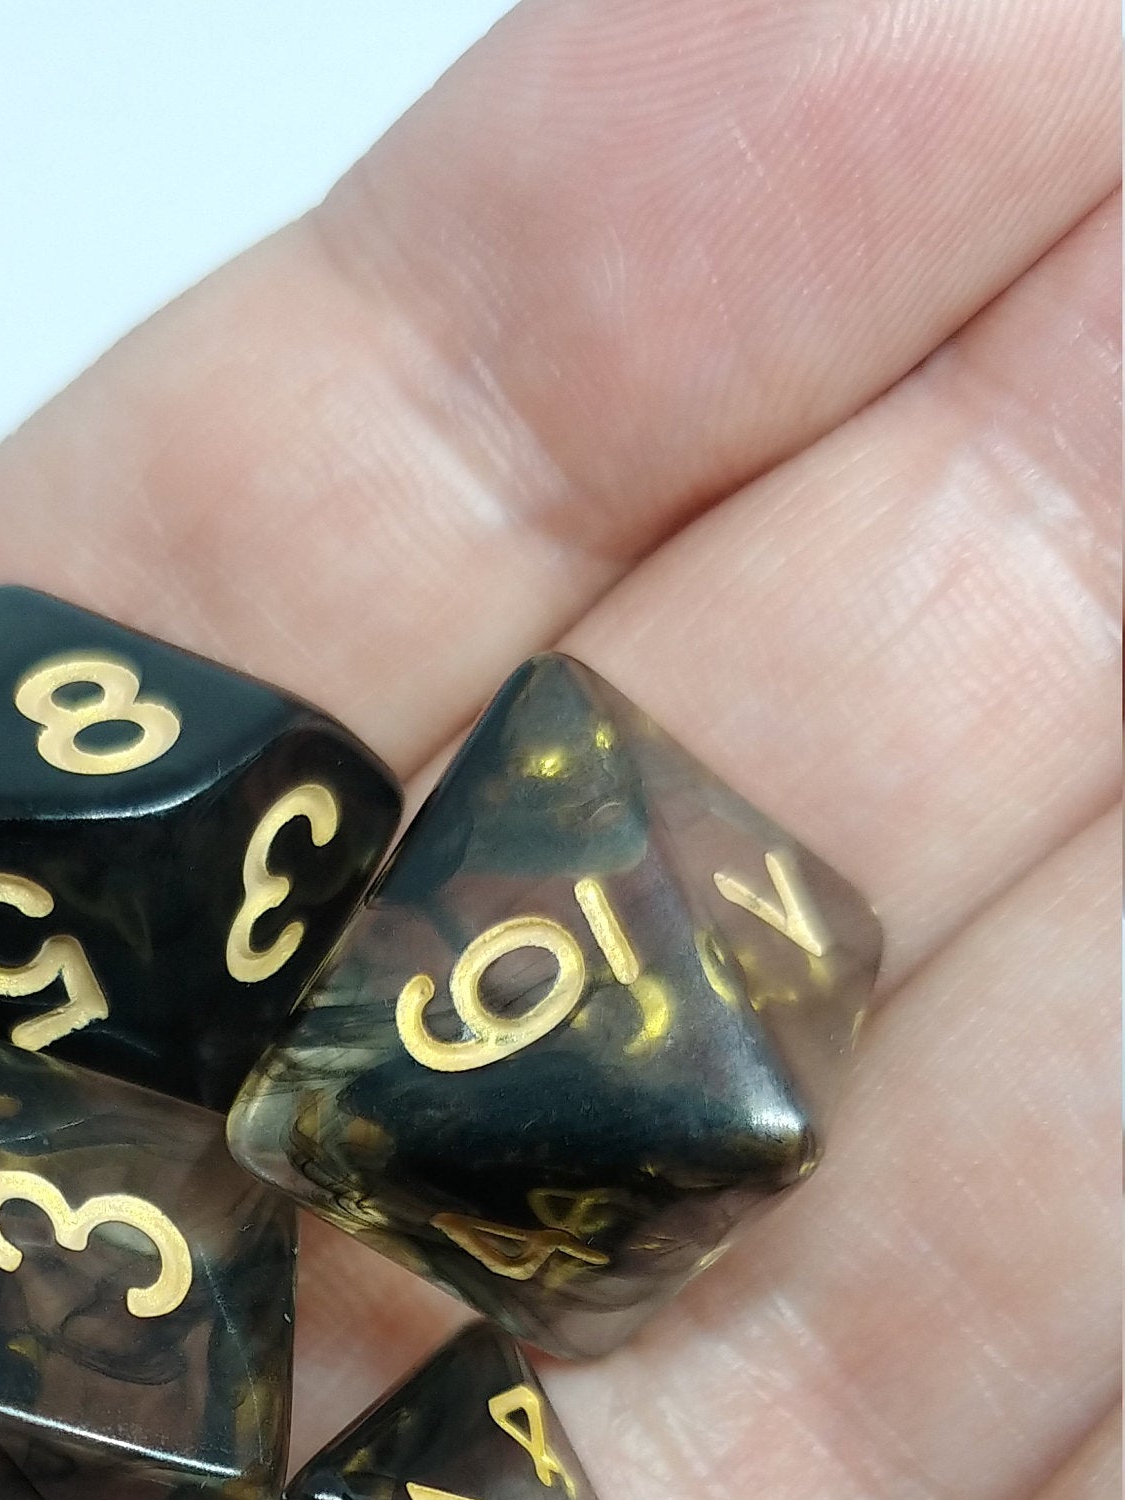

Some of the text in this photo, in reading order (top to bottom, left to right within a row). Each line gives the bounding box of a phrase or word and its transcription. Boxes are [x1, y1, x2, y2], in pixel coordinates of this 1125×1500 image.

[15, 660, 180, 775] 8
[226, 783, 339, 983] 3
[488, 1384, 576, 1500] 4
